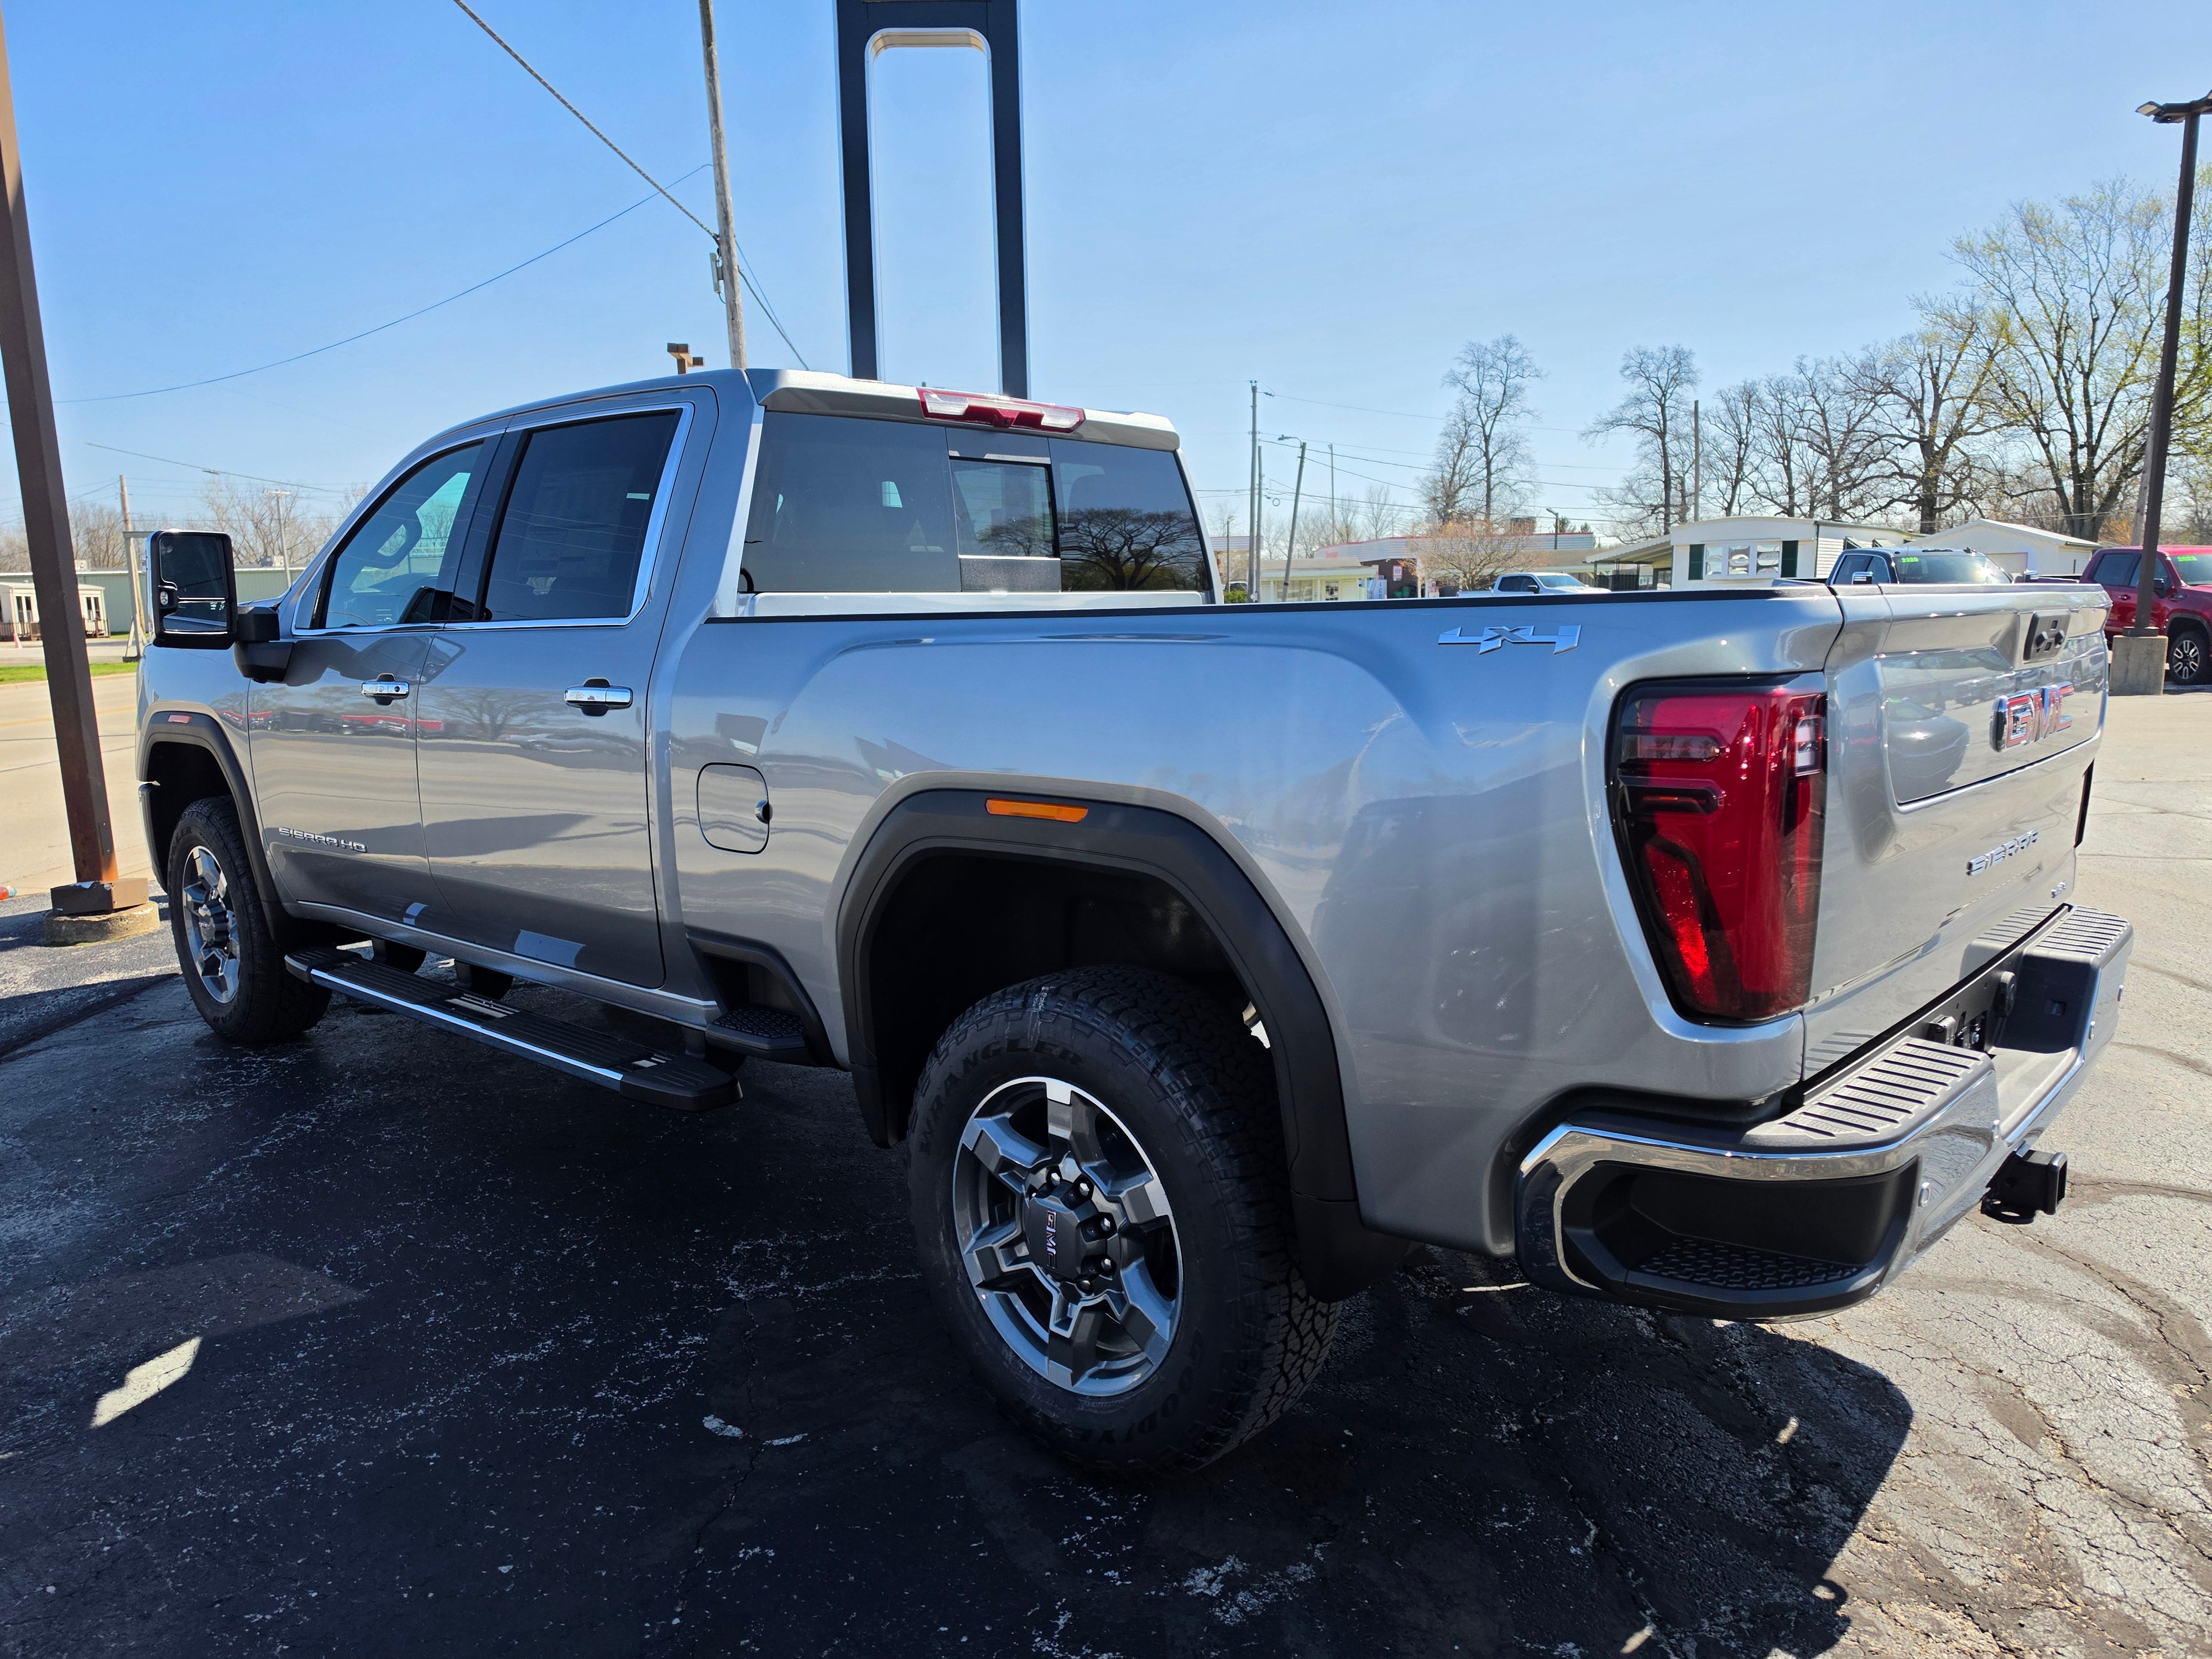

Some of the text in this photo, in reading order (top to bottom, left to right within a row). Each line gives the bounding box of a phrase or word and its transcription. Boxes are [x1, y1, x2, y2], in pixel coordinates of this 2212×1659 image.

[1990, 681, 2075, 752] GMC
[279, 827, 368, 853] SIERRA HD
[1966, 827, 2039, 877] SIERRA
[918, 1039, 1084, 1156] WRANGLER
[1046, 1210, 1057, 1270] GMC
